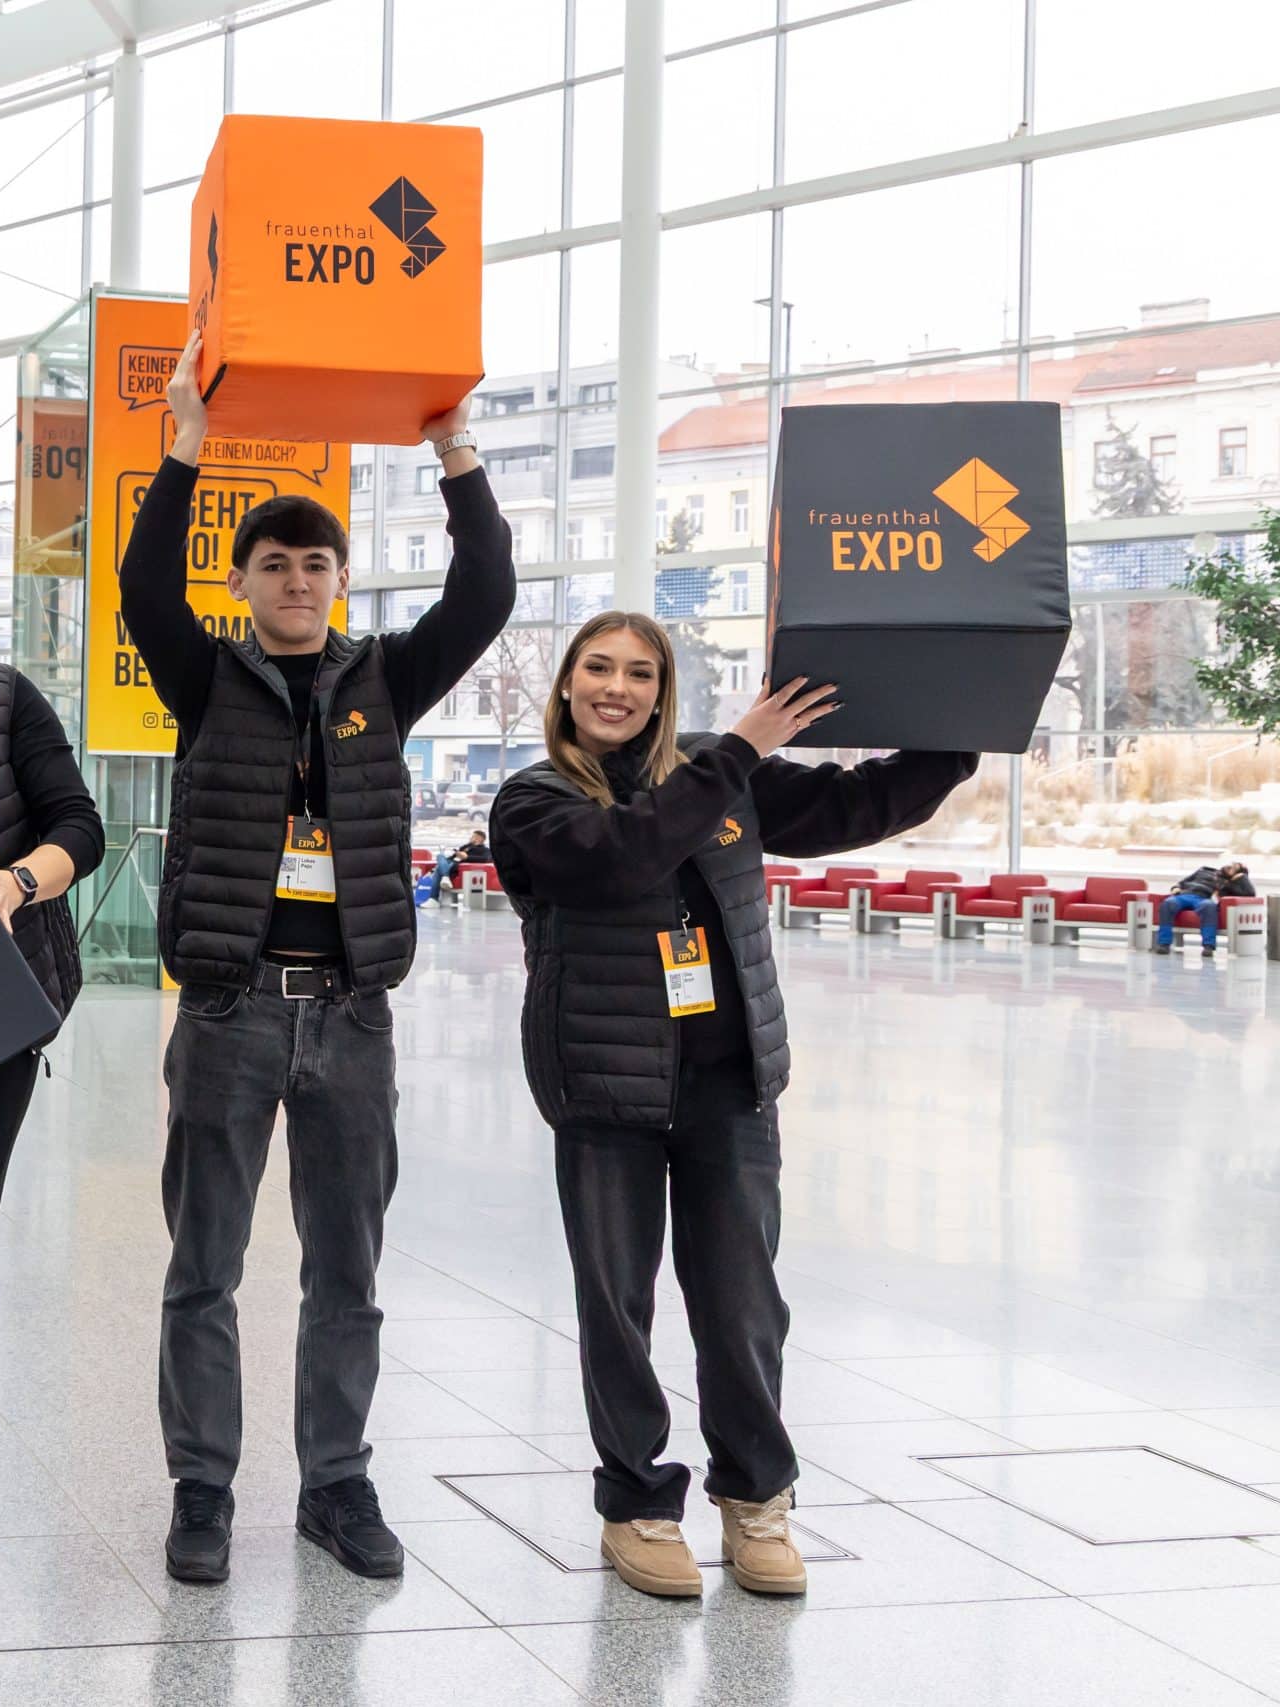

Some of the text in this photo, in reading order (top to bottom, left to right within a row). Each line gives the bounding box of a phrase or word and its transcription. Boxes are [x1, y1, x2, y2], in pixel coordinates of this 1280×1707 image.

[266, 220, 374, 239] frauenthal
[285, 243, 375, 285] EXPO
[128, 354, 178, 375] KEINER
[128, 375, 163, 394] EXPO
[214, 441, 253, 460] EINEM
[255, 443, 297, 463] DACH?
[808, 508, 941, 526] frauenthal
[831, 531, 943, 572] EXPO
[336, 725, 358, 739] EXPO
[298, 839, 316, 849] EXPO
